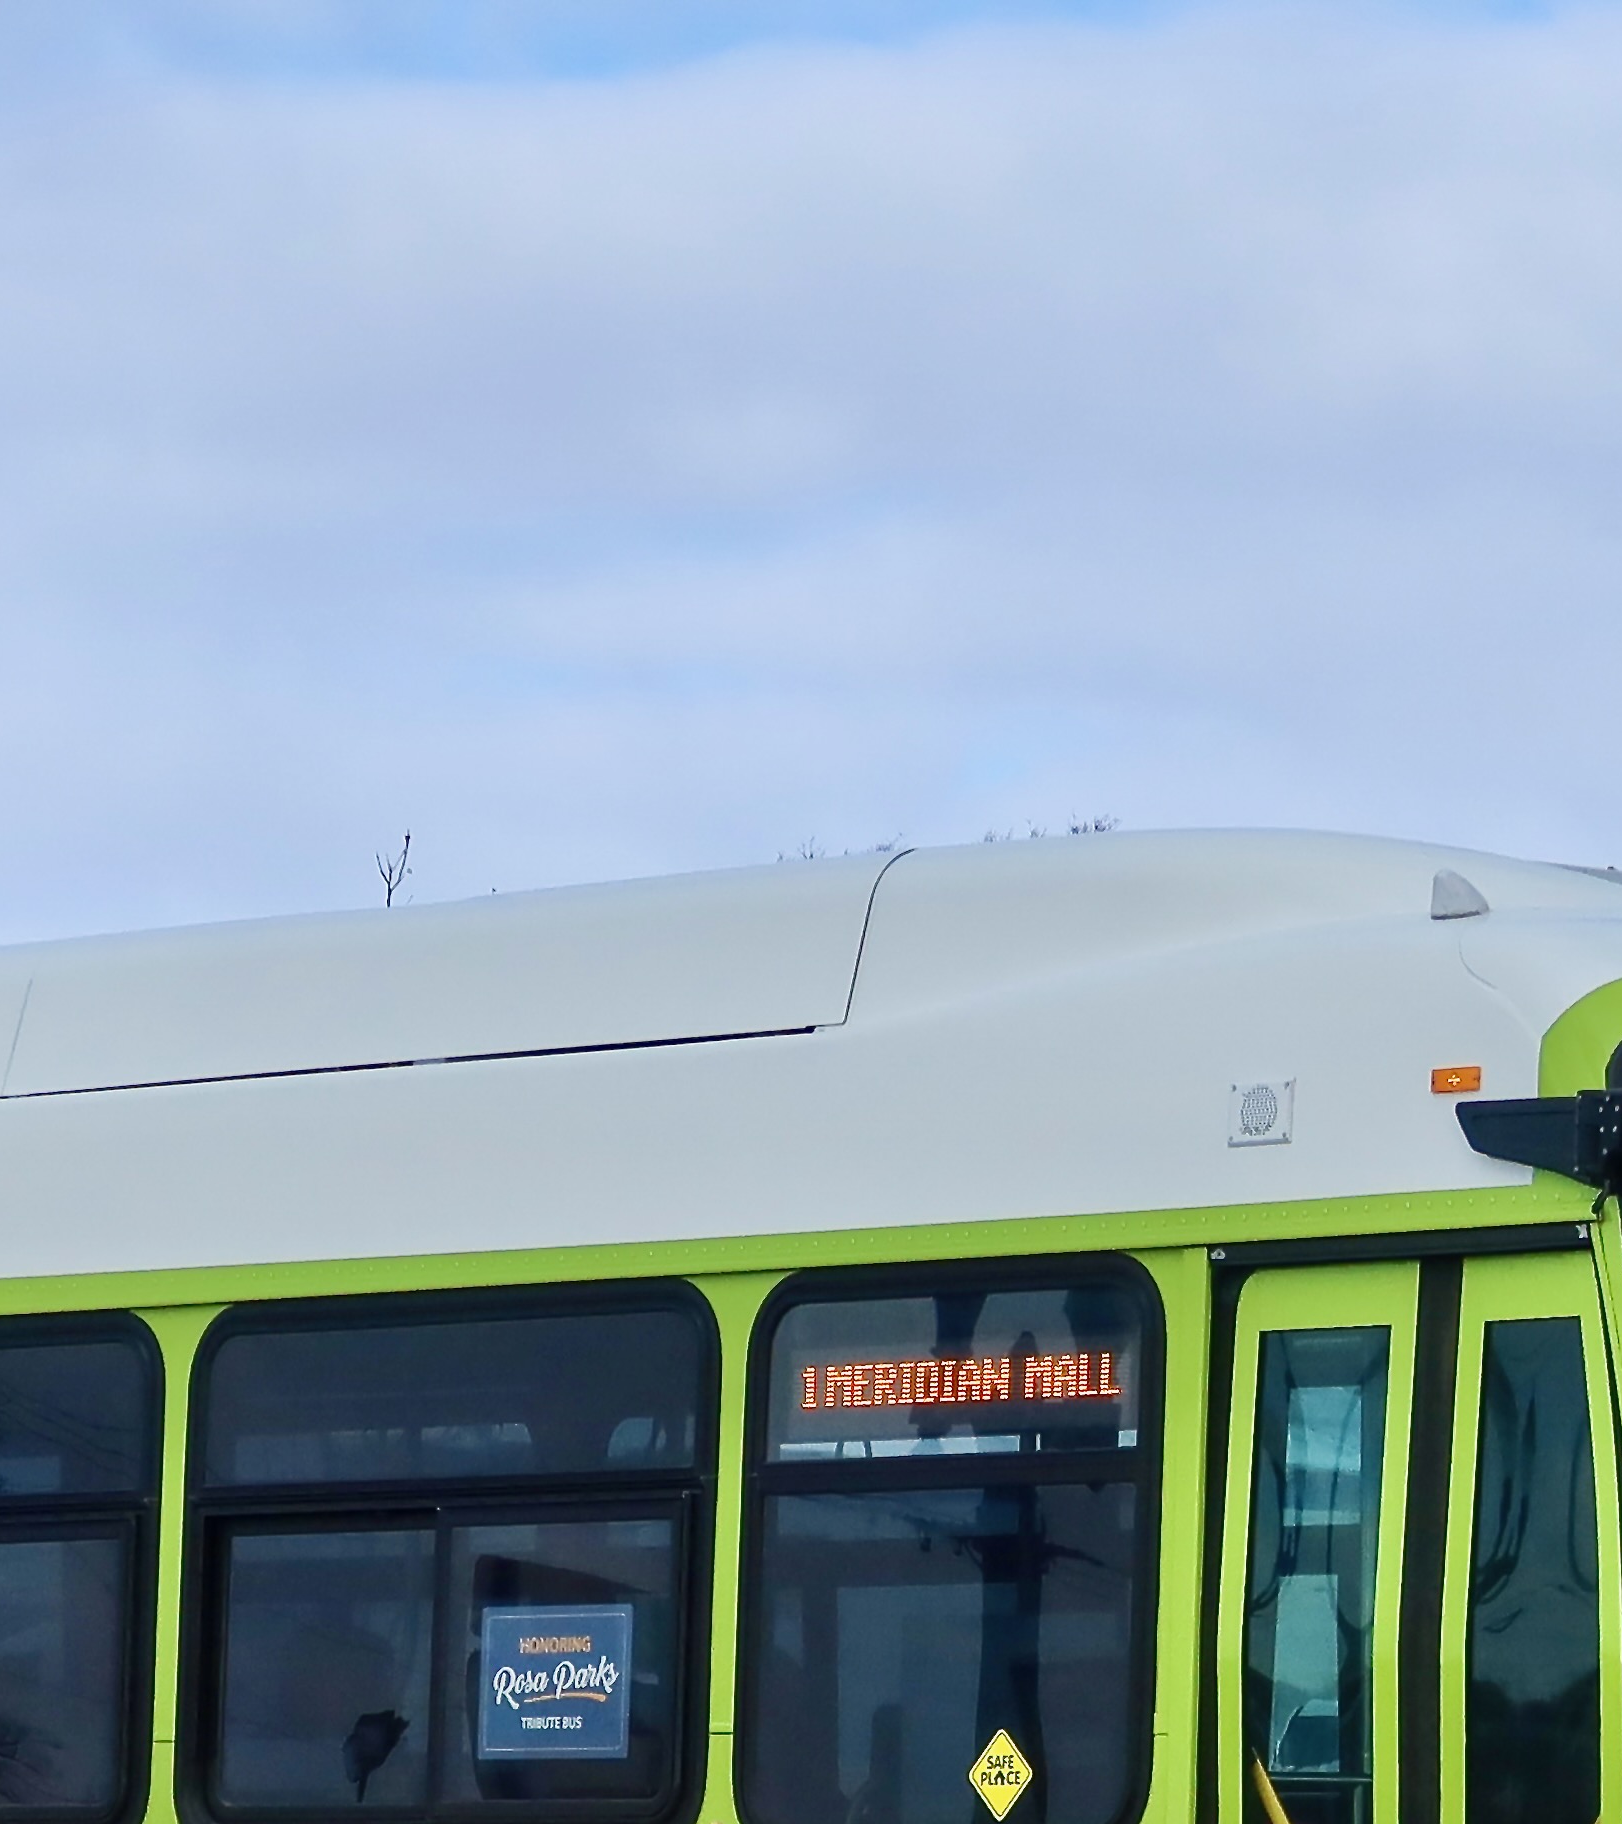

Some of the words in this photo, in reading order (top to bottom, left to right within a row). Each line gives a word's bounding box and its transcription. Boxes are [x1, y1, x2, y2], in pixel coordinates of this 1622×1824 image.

[824, 1358, 1010, 1408] MERIDIAN
[1024, 1352, 1122, 1400] MALL
[519, 1636, 591, 1653] HONORING
[493, 1667, 550, 1710] Rosa
[552, 1656, 619, 1699] Parks
[521, 1717, 561, 1729] TRIBUTE
[562, 1716, 583, 1729] BUS
[987, 1755, 1014, 1769] SAFE
